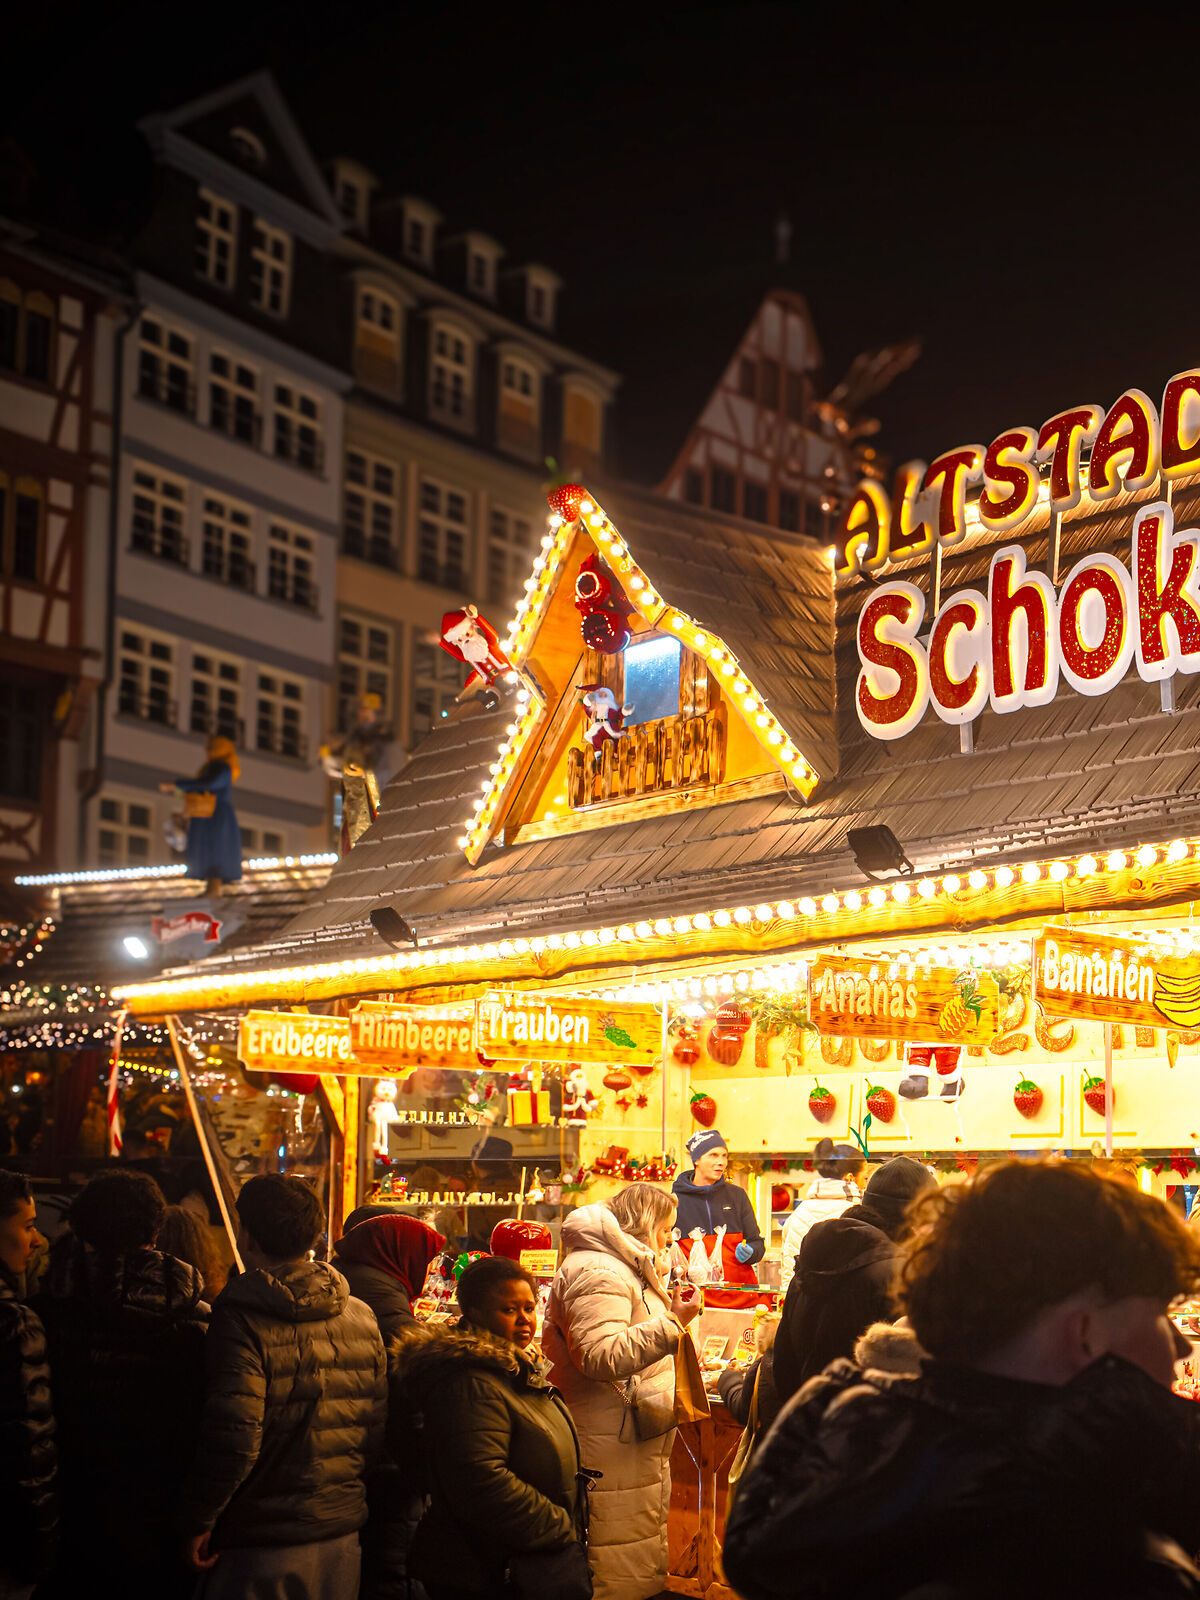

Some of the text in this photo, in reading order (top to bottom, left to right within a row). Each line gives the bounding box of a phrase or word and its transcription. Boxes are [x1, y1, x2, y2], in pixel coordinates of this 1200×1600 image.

[819, 967, 919, 1019] Ananas
[1043, 939, 1154, 1005] Bananen
[487, 1003, 590, 1045] Trauben
